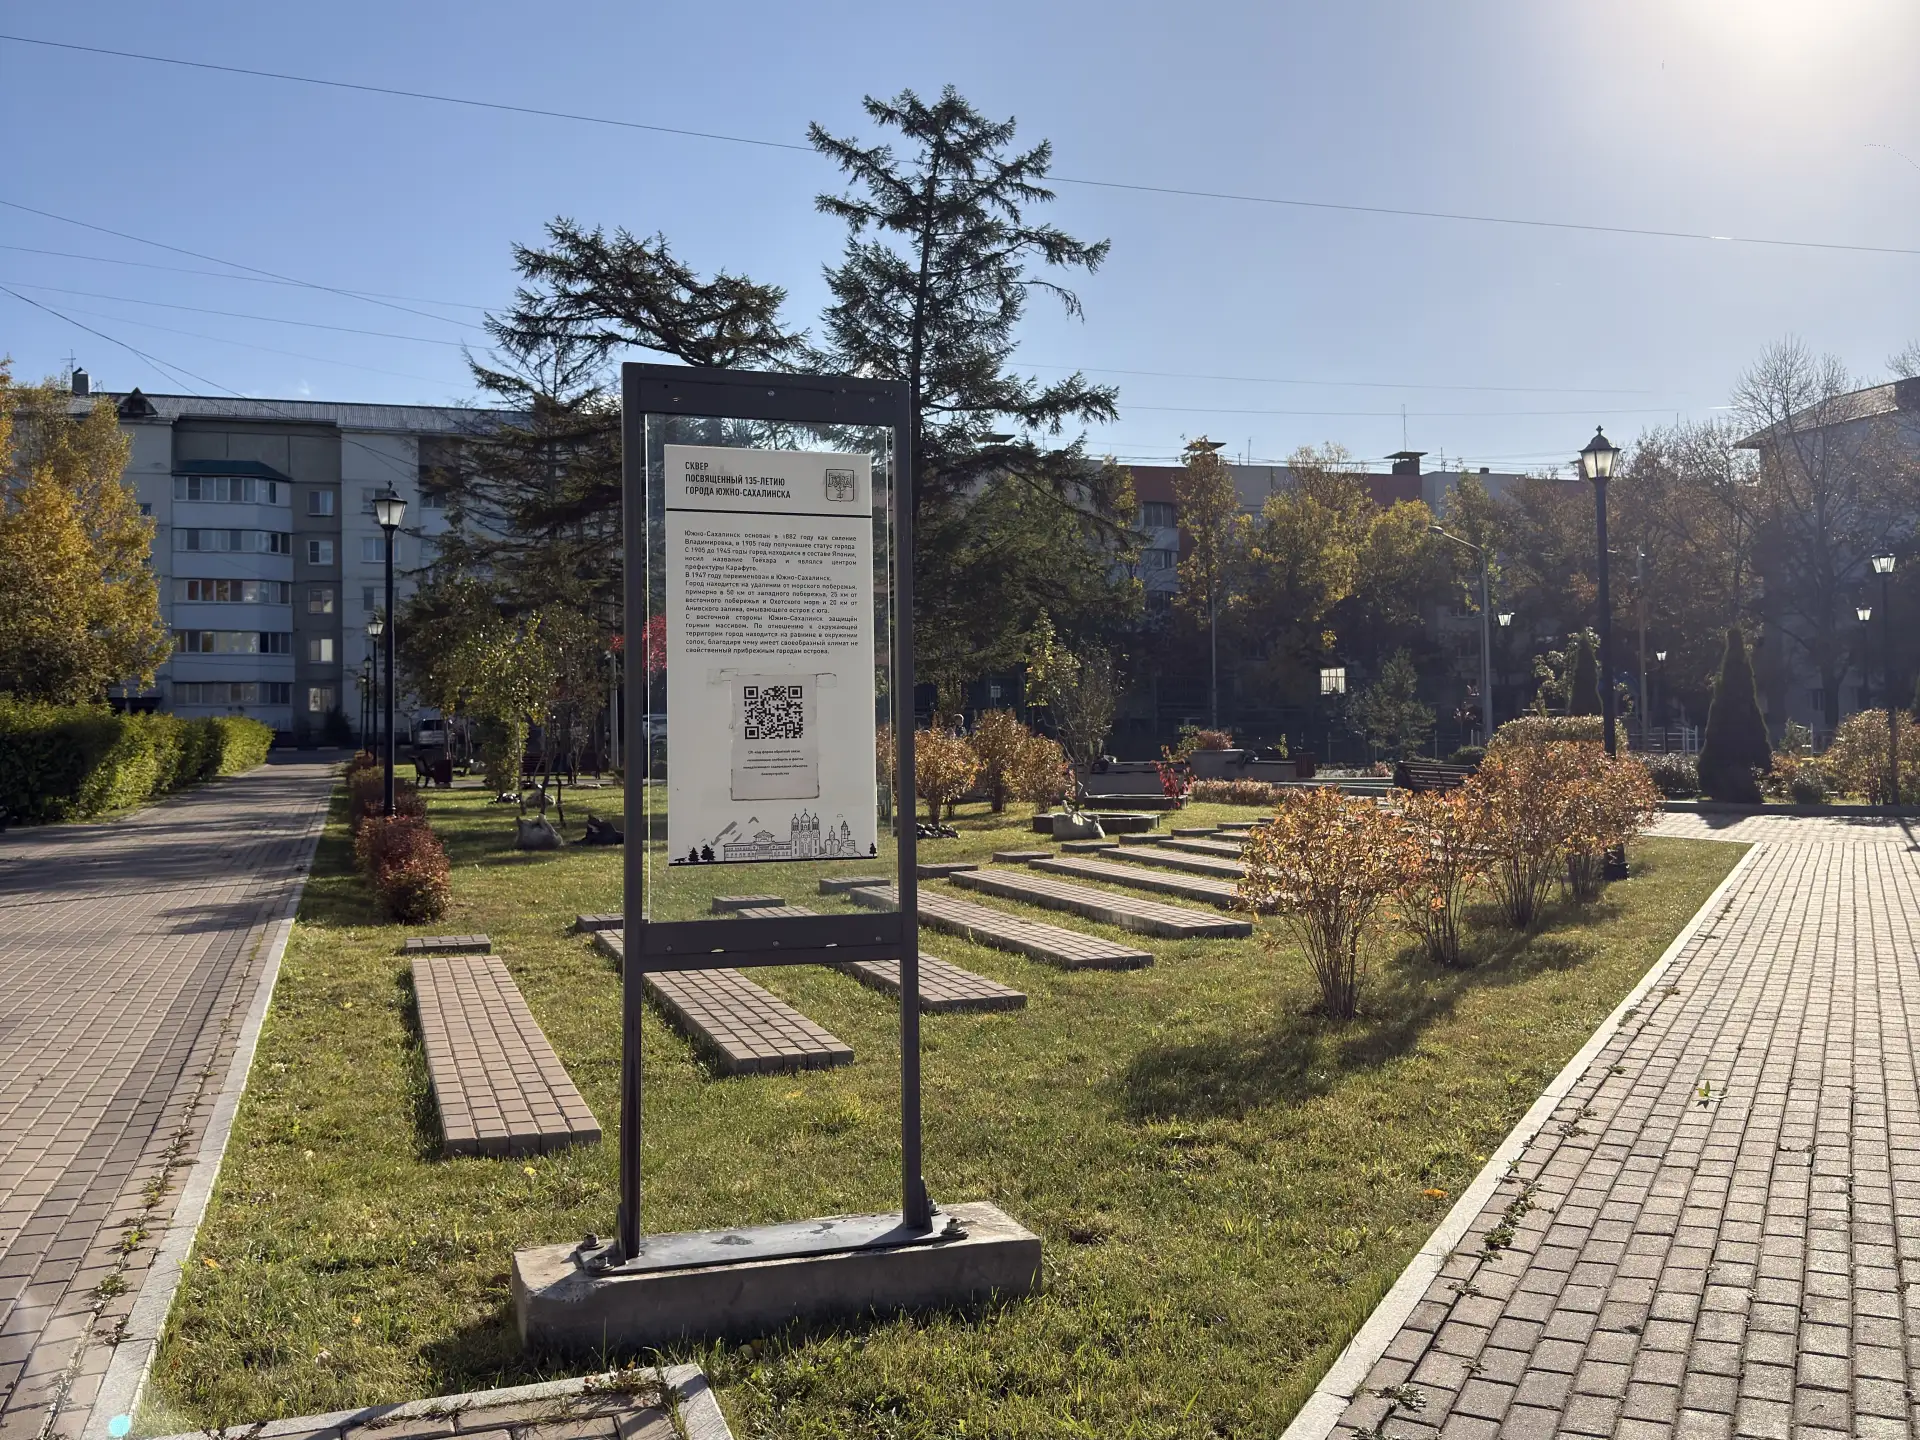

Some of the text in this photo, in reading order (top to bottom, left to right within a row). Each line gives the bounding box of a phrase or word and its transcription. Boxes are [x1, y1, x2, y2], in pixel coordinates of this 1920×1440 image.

[685, 462, 708, 470] СКВЕР
[685, 474, 785, 486] ПОСВЯЩЕННЫЙ 135-ЛЕТИЮ
[685, 487, 791, 498] ГОРОДА ЮЖНО-САХАЛИНСКА
